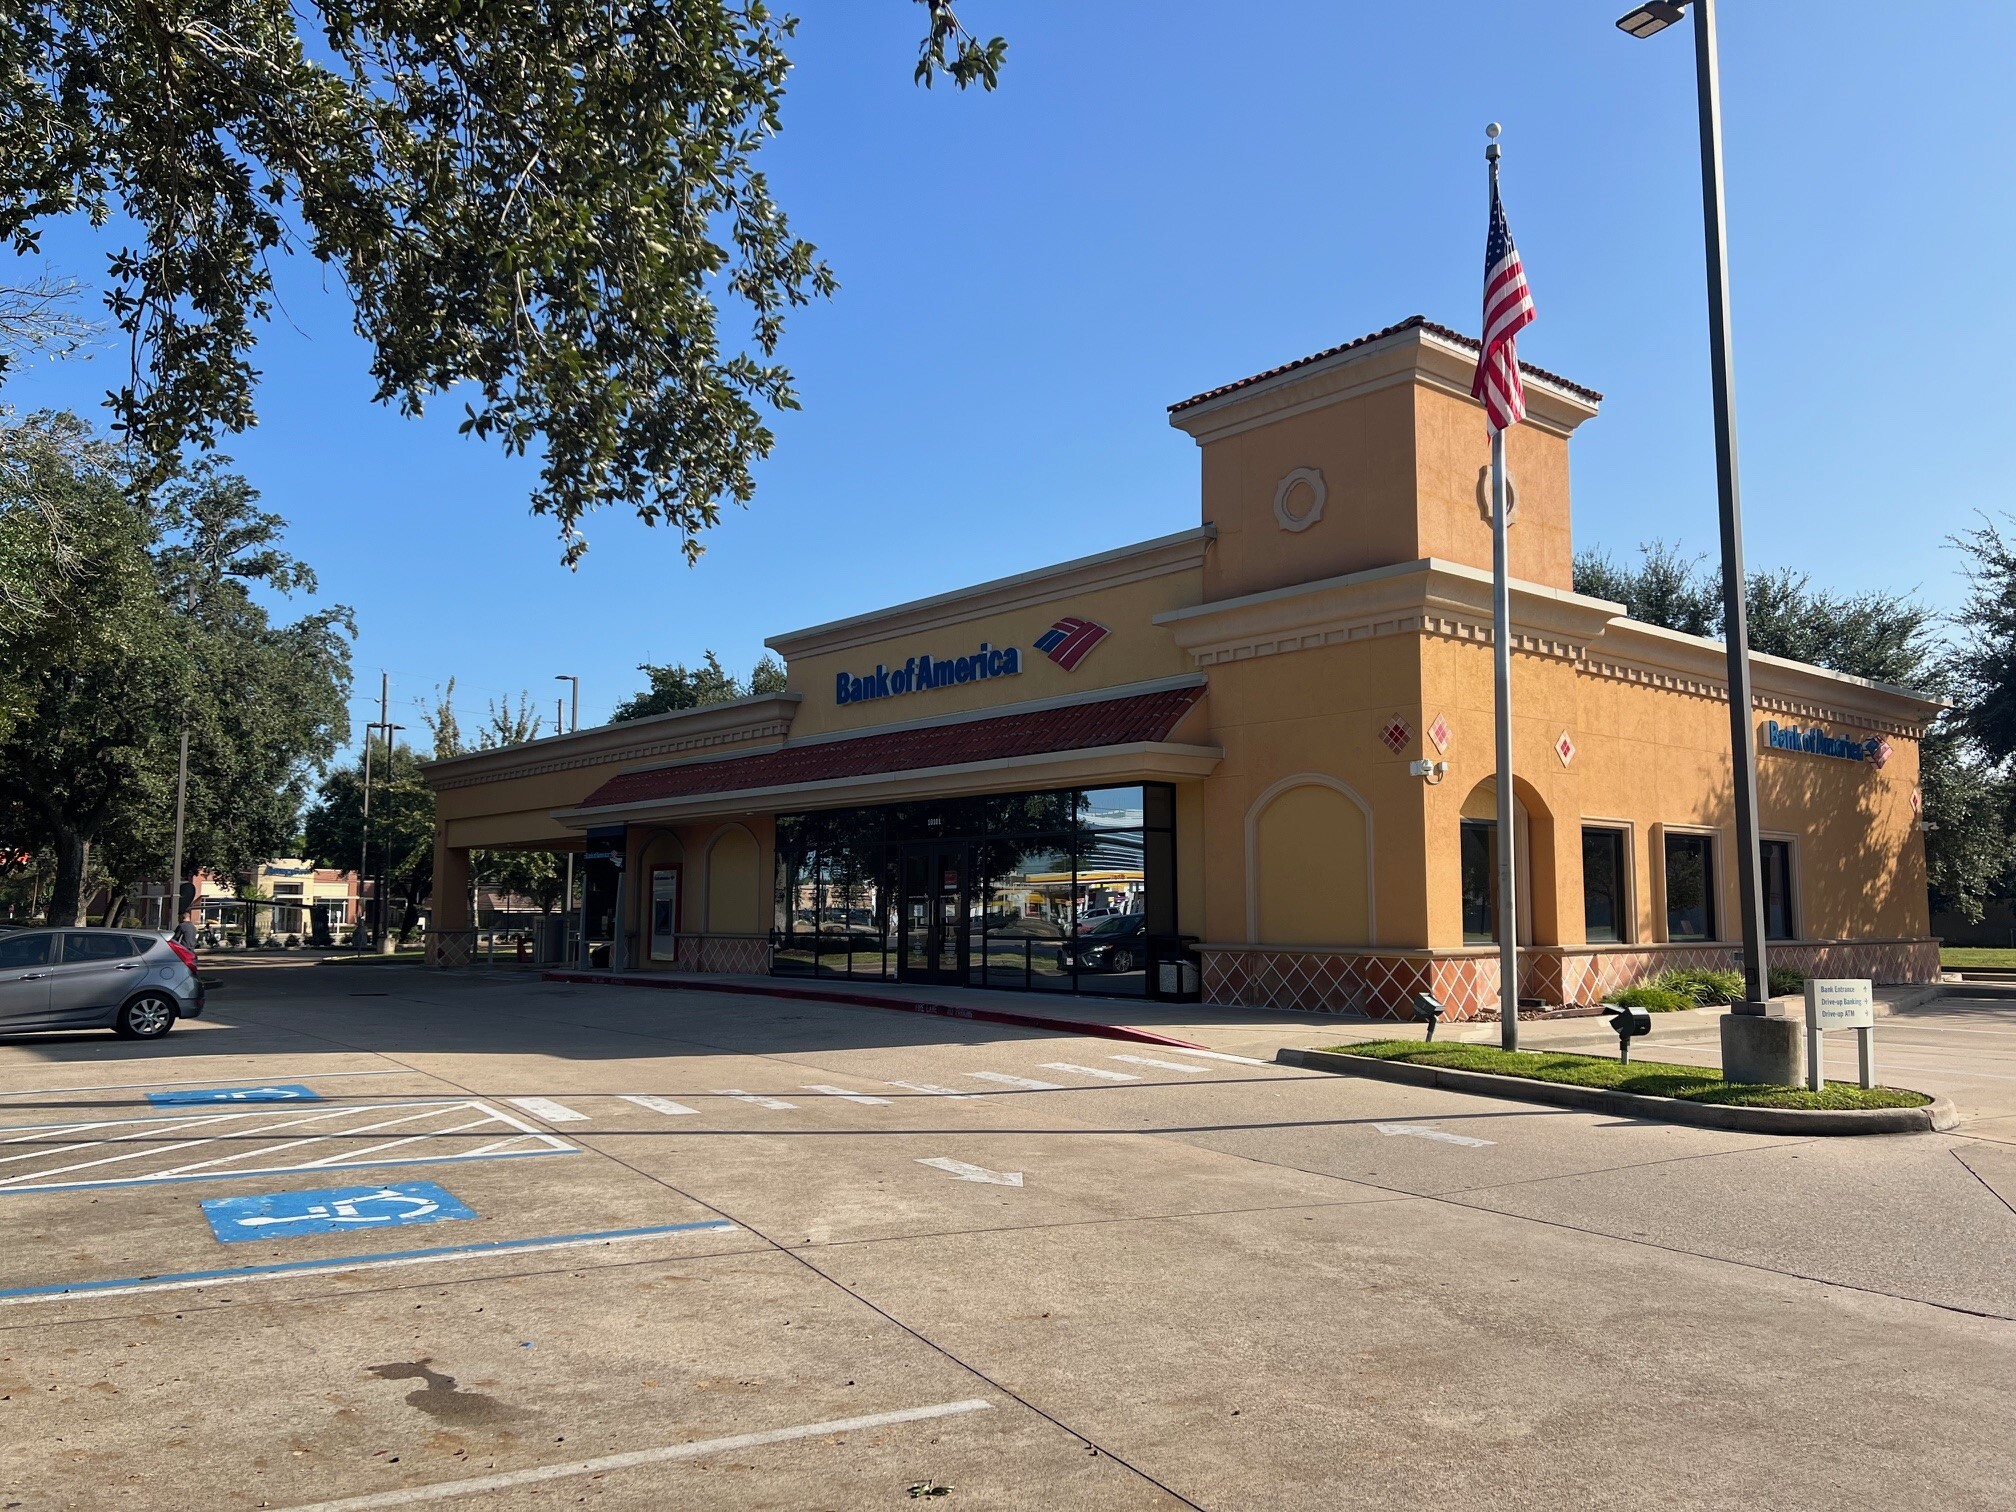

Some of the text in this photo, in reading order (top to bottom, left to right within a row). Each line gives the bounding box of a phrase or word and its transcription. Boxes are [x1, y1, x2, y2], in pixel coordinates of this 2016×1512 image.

[836, 643, 1020, 705] Bank of America
[1769, 720, 1864, 761] Bank of America
[1821, 998, 1862, 1006] Drive-up Banking
[1822, 1010, 1843, 1018] Drive-up
